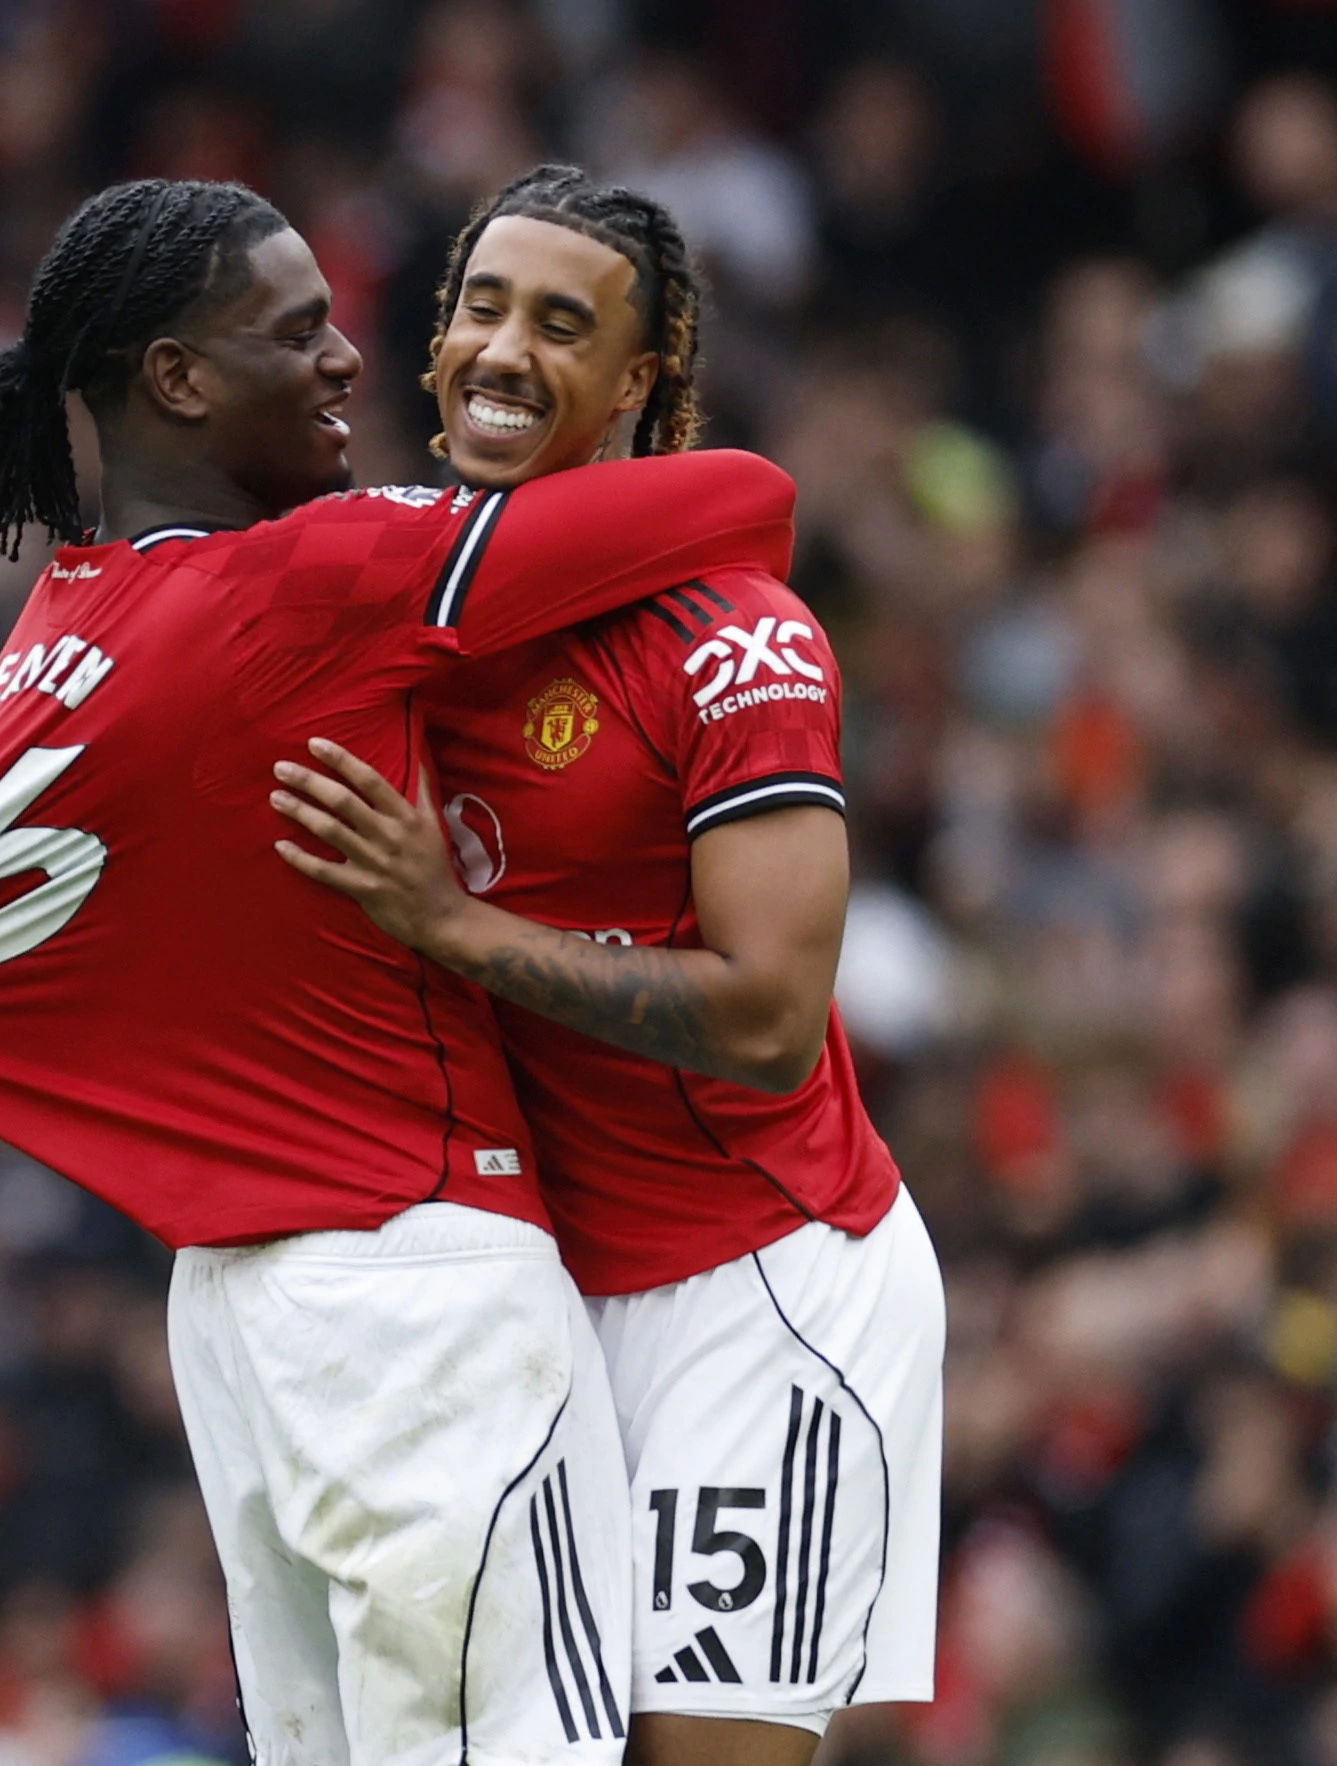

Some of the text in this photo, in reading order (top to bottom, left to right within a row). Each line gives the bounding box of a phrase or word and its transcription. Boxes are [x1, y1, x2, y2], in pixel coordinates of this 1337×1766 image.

[683, 617, 824, 707] DXC
[697, 683, 827, 725] TECHNOLOGY
[534, 746, 579, 763] UNITED
[648, 1486, 767, 1613] 15
